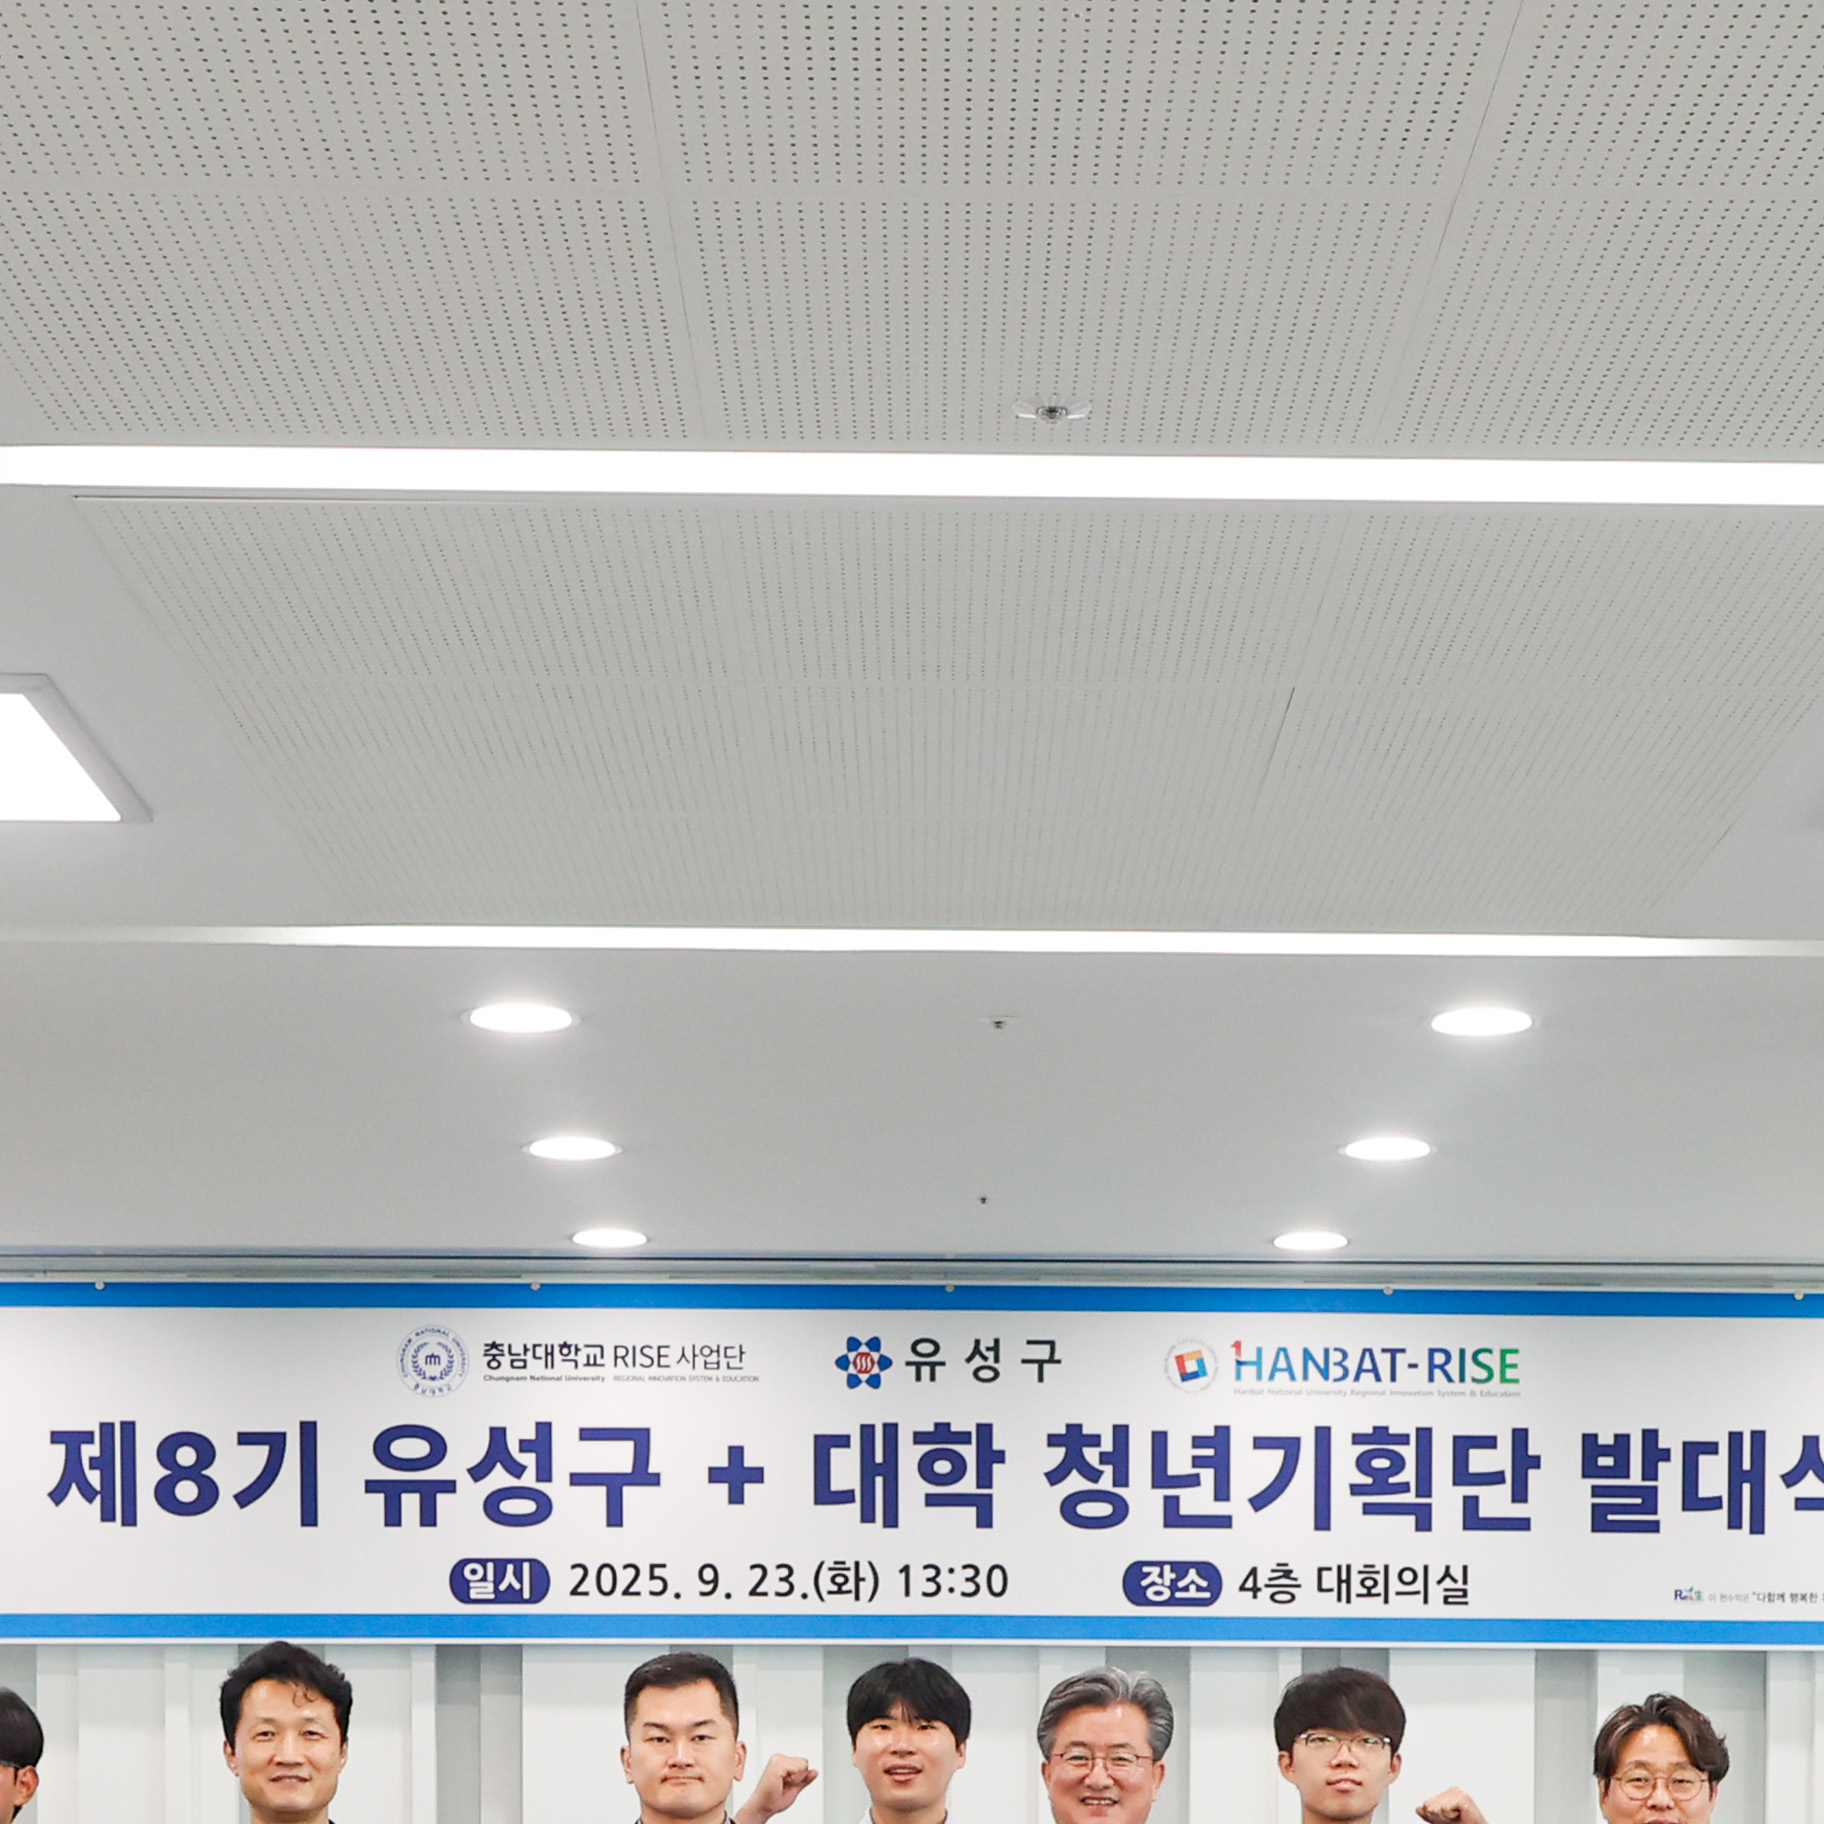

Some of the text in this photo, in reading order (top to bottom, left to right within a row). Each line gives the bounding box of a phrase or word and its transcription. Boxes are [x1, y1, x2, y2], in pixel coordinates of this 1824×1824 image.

[483, 1340, 747, 1371] 충남대학교 RISE 사업단
[47, 1420, 320, 1529] 제8기
[363, 1420, 662, 1530] 유성구
[707, 1442, 766, 1507] +
[813, 1421, 1005, 1530] 대학
[1042, 1423, 1542, 1534] 청년기획단
[462, 1563, 536, 1601] 일시
[569, 1557, 1010, 1605] 2025. 9. 23.(화) 13:30
[1139, 1561, 1210, 1603] 장소
[1238, 1560, 1472, 1607] 4층 대회의실
